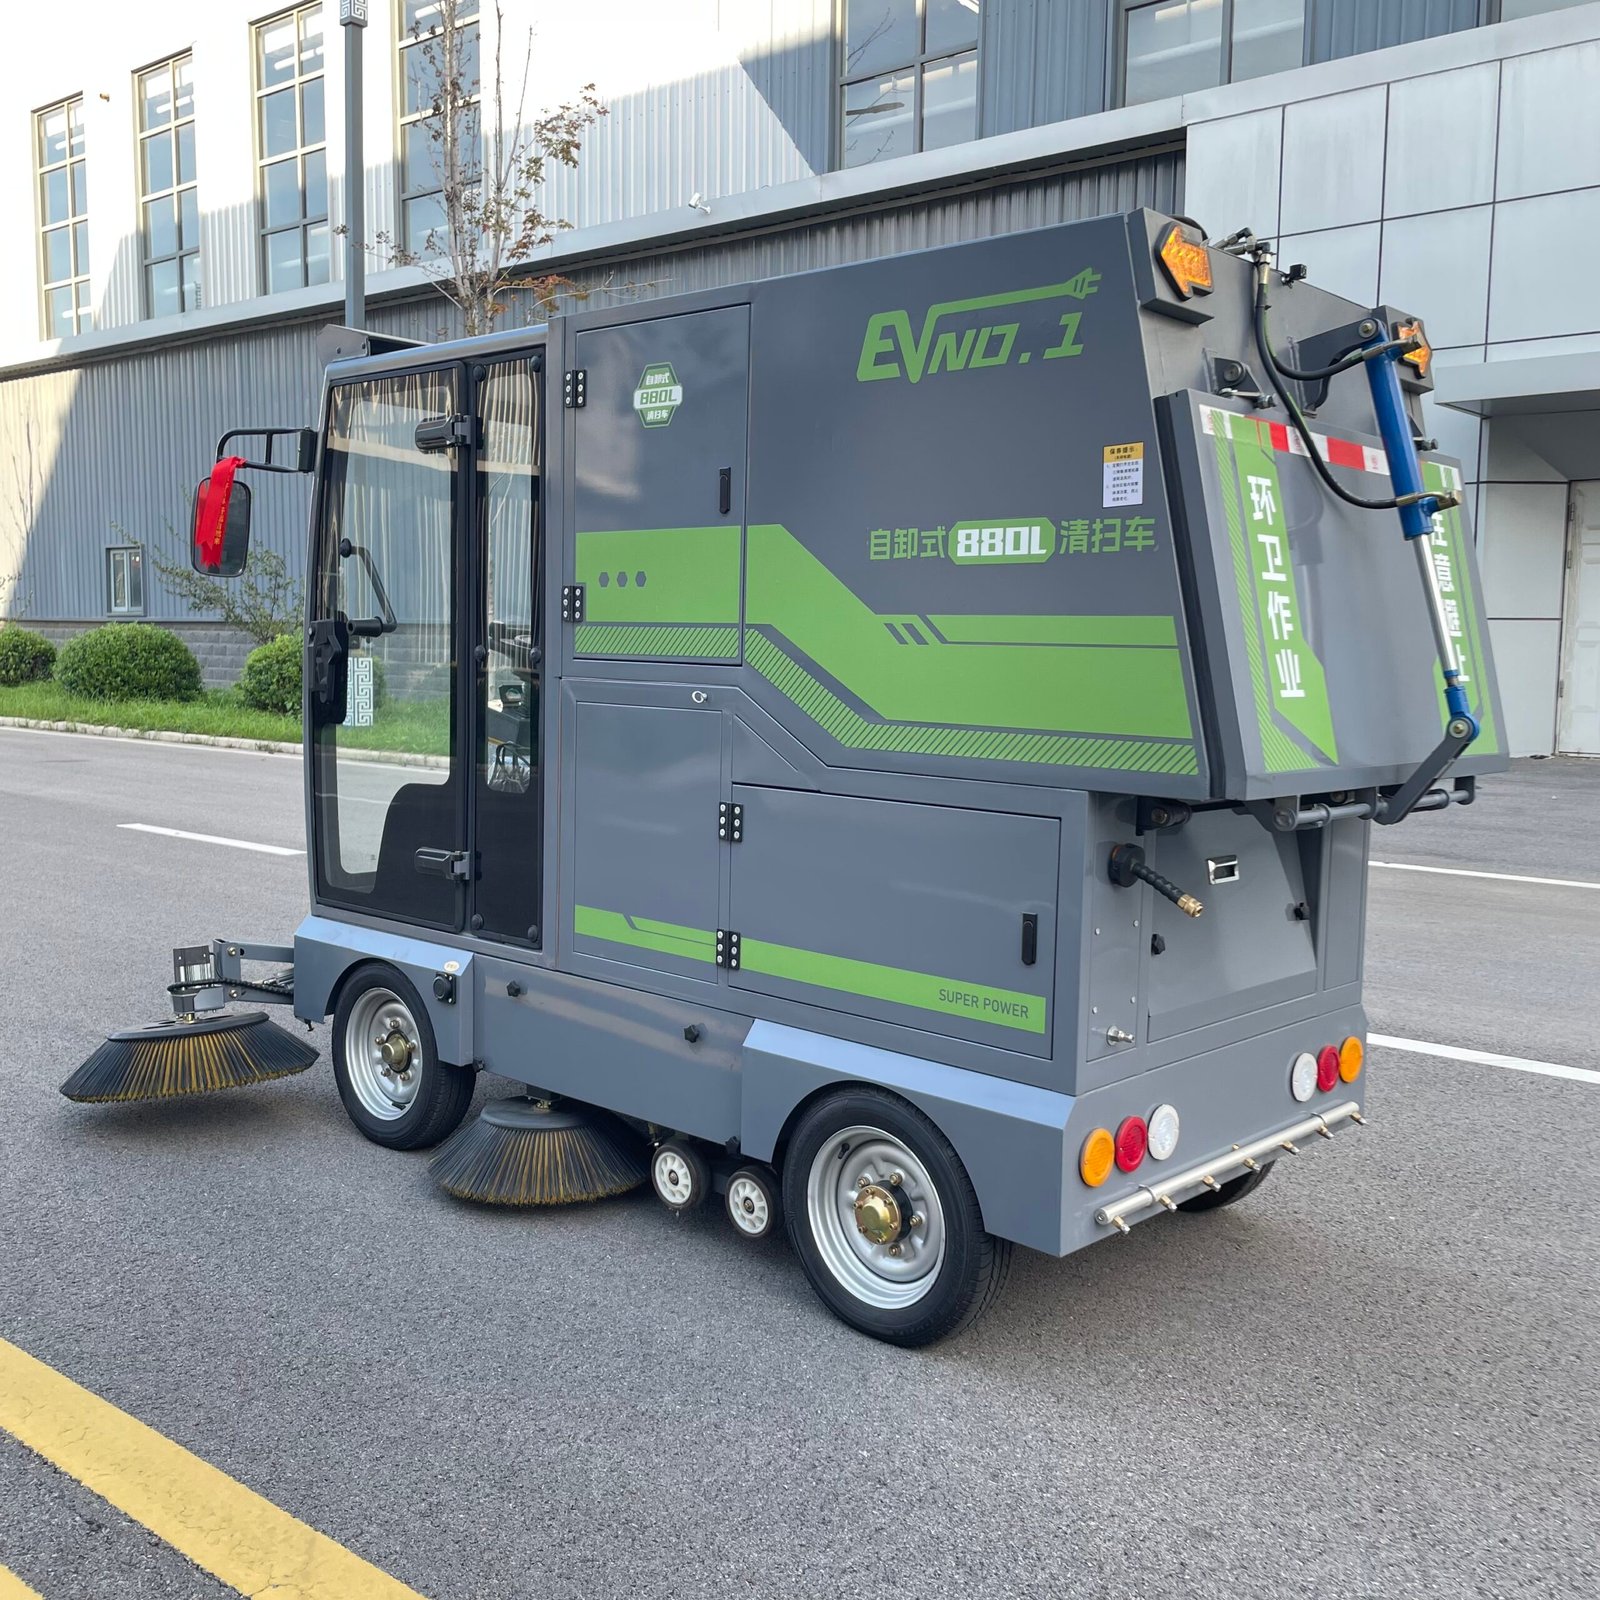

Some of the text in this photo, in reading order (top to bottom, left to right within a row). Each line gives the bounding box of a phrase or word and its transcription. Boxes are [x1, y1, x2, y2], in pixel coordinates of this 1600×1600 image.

[640, 389, 677, 405] 880L
[869, 515, 1156, 560] 自卸式 880L 清扫车
[1247, 475, 1306, 698] 环卫作业
[939, 989, 1029, 1018] SUPER POWER
